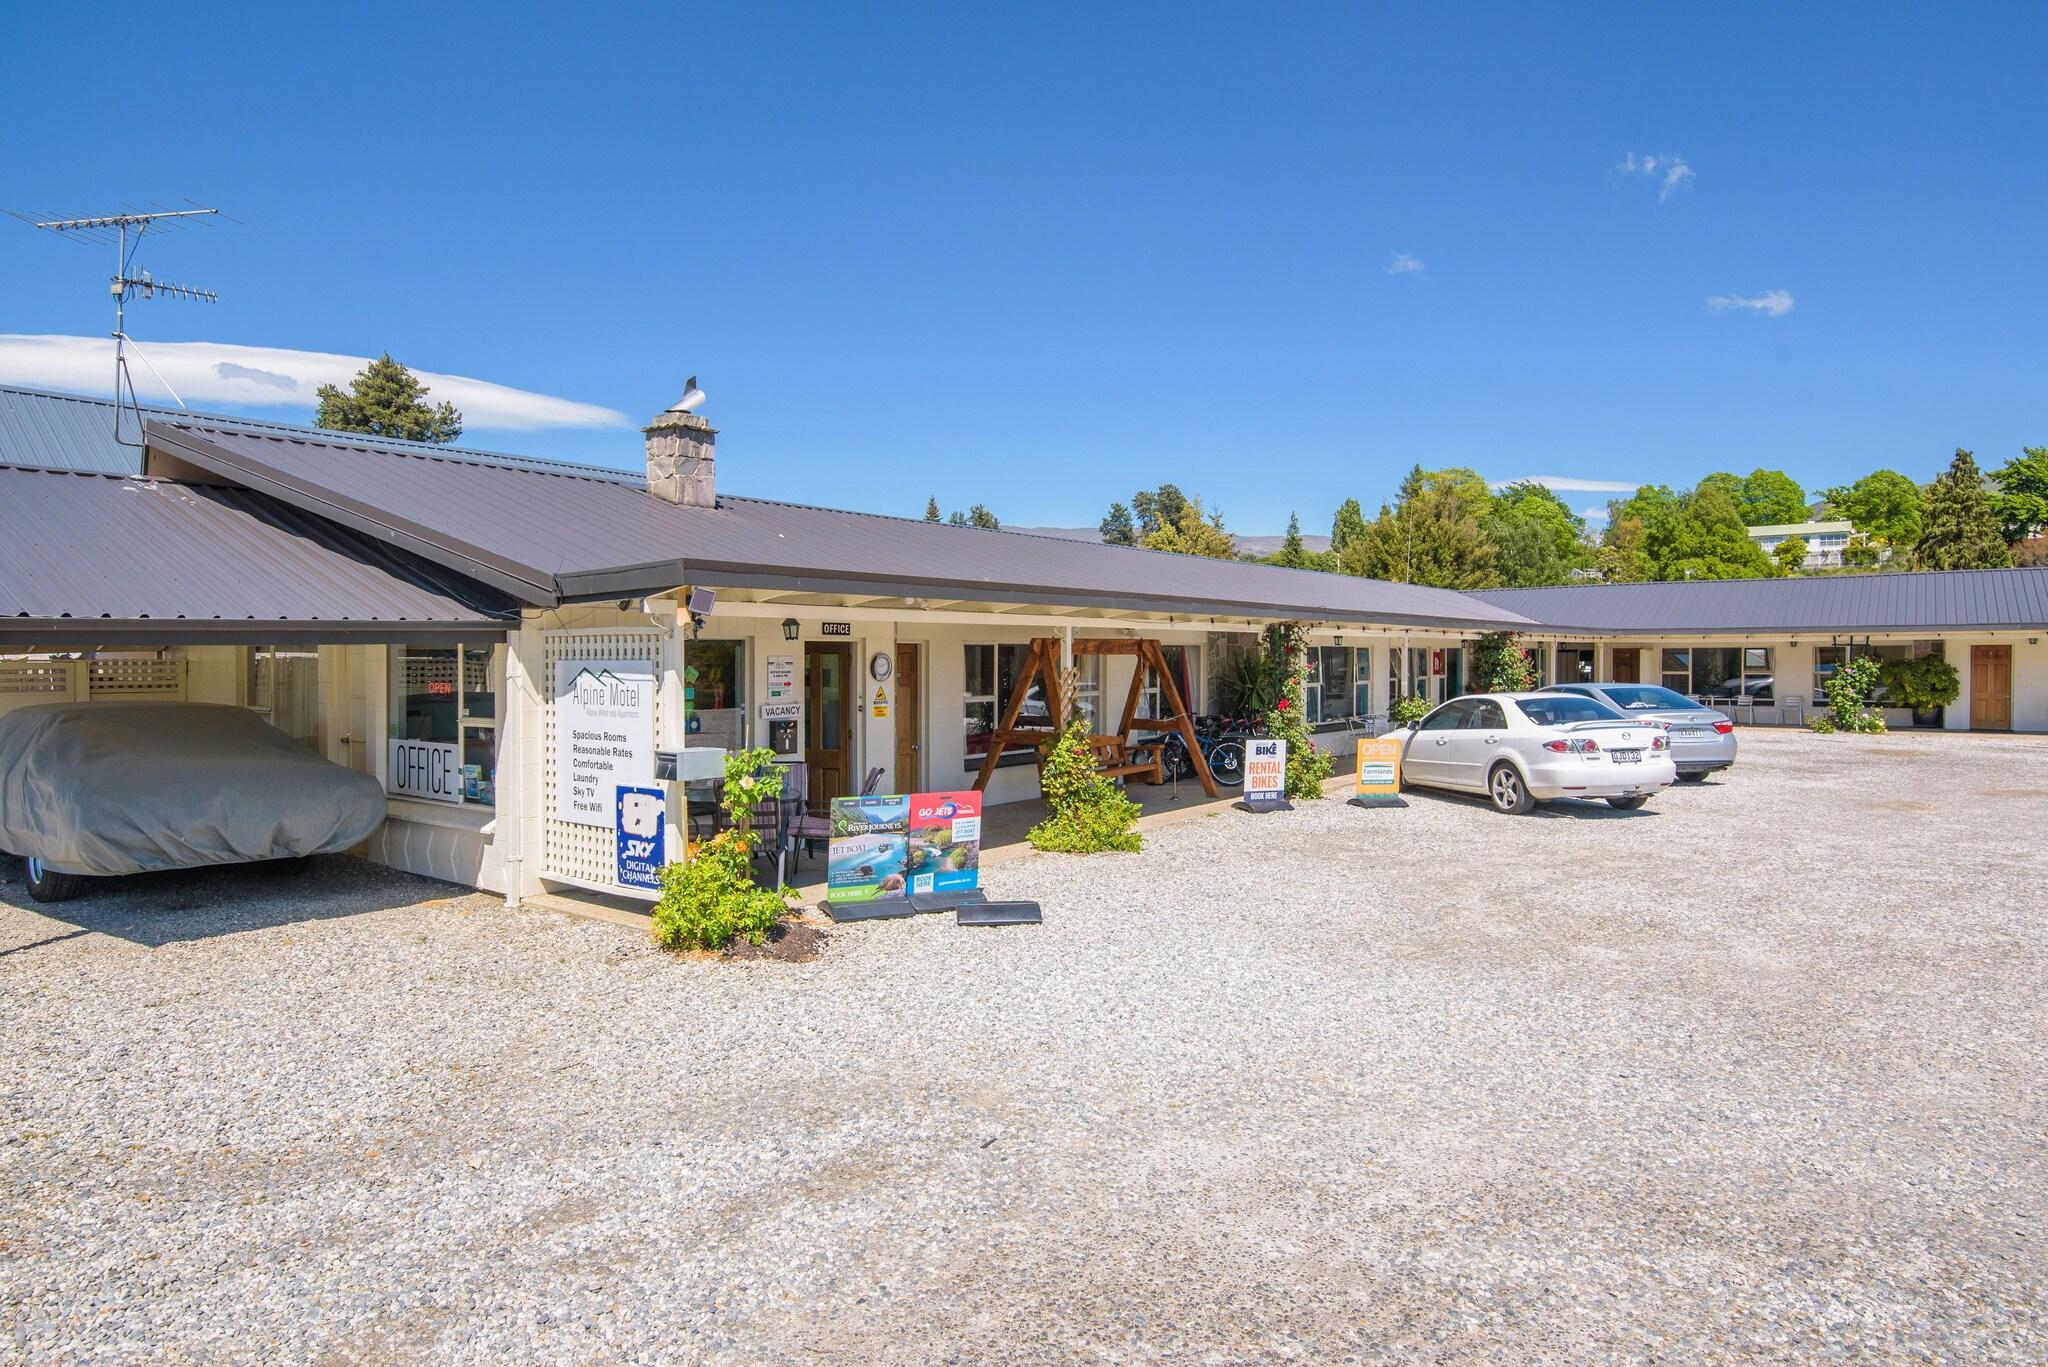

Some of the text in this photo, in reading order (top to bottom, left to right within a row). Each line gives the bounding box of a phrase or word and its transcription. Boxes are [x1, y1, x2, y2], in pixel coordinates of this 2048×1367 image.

[824, 623, 849, 633] OFFICE
[427, 682, 451, 694] OPEN
[573, 681, 640, 710] Alpine Motel
[765, 706, 800, 717] VACANCY
[572, 729, 627, 743] Spacious Rooms
[573, 744, 633, 758] Reasonable Rates
[1256, 742, 1277, 755] BIKE
[1362, 742, 1398, 756] OPEN
[397, 744, 452, 795] OFFICE
[573, 758, 614, 771] Comfortable
[1249, 761, 1282, 775] RENTAL
[573, 772, 599, 786] Laundry
[1251, 775, 1278, 789] BIKES
[573, 786, 595, 799] Sky TV
[1251, 791, 1278, 800] BOOK HERE
[573, 800, 603, 813] Free Wifi
[919, 806, 953, 816] GO JETS
[622, 840, 656, 859] SKY
[832, 847, 845, 855] JET
[846, 845, 867, 854] BOAT
[622, 870, 660, 885] CHANNELS
[916, 880, 930, 888] HERE
